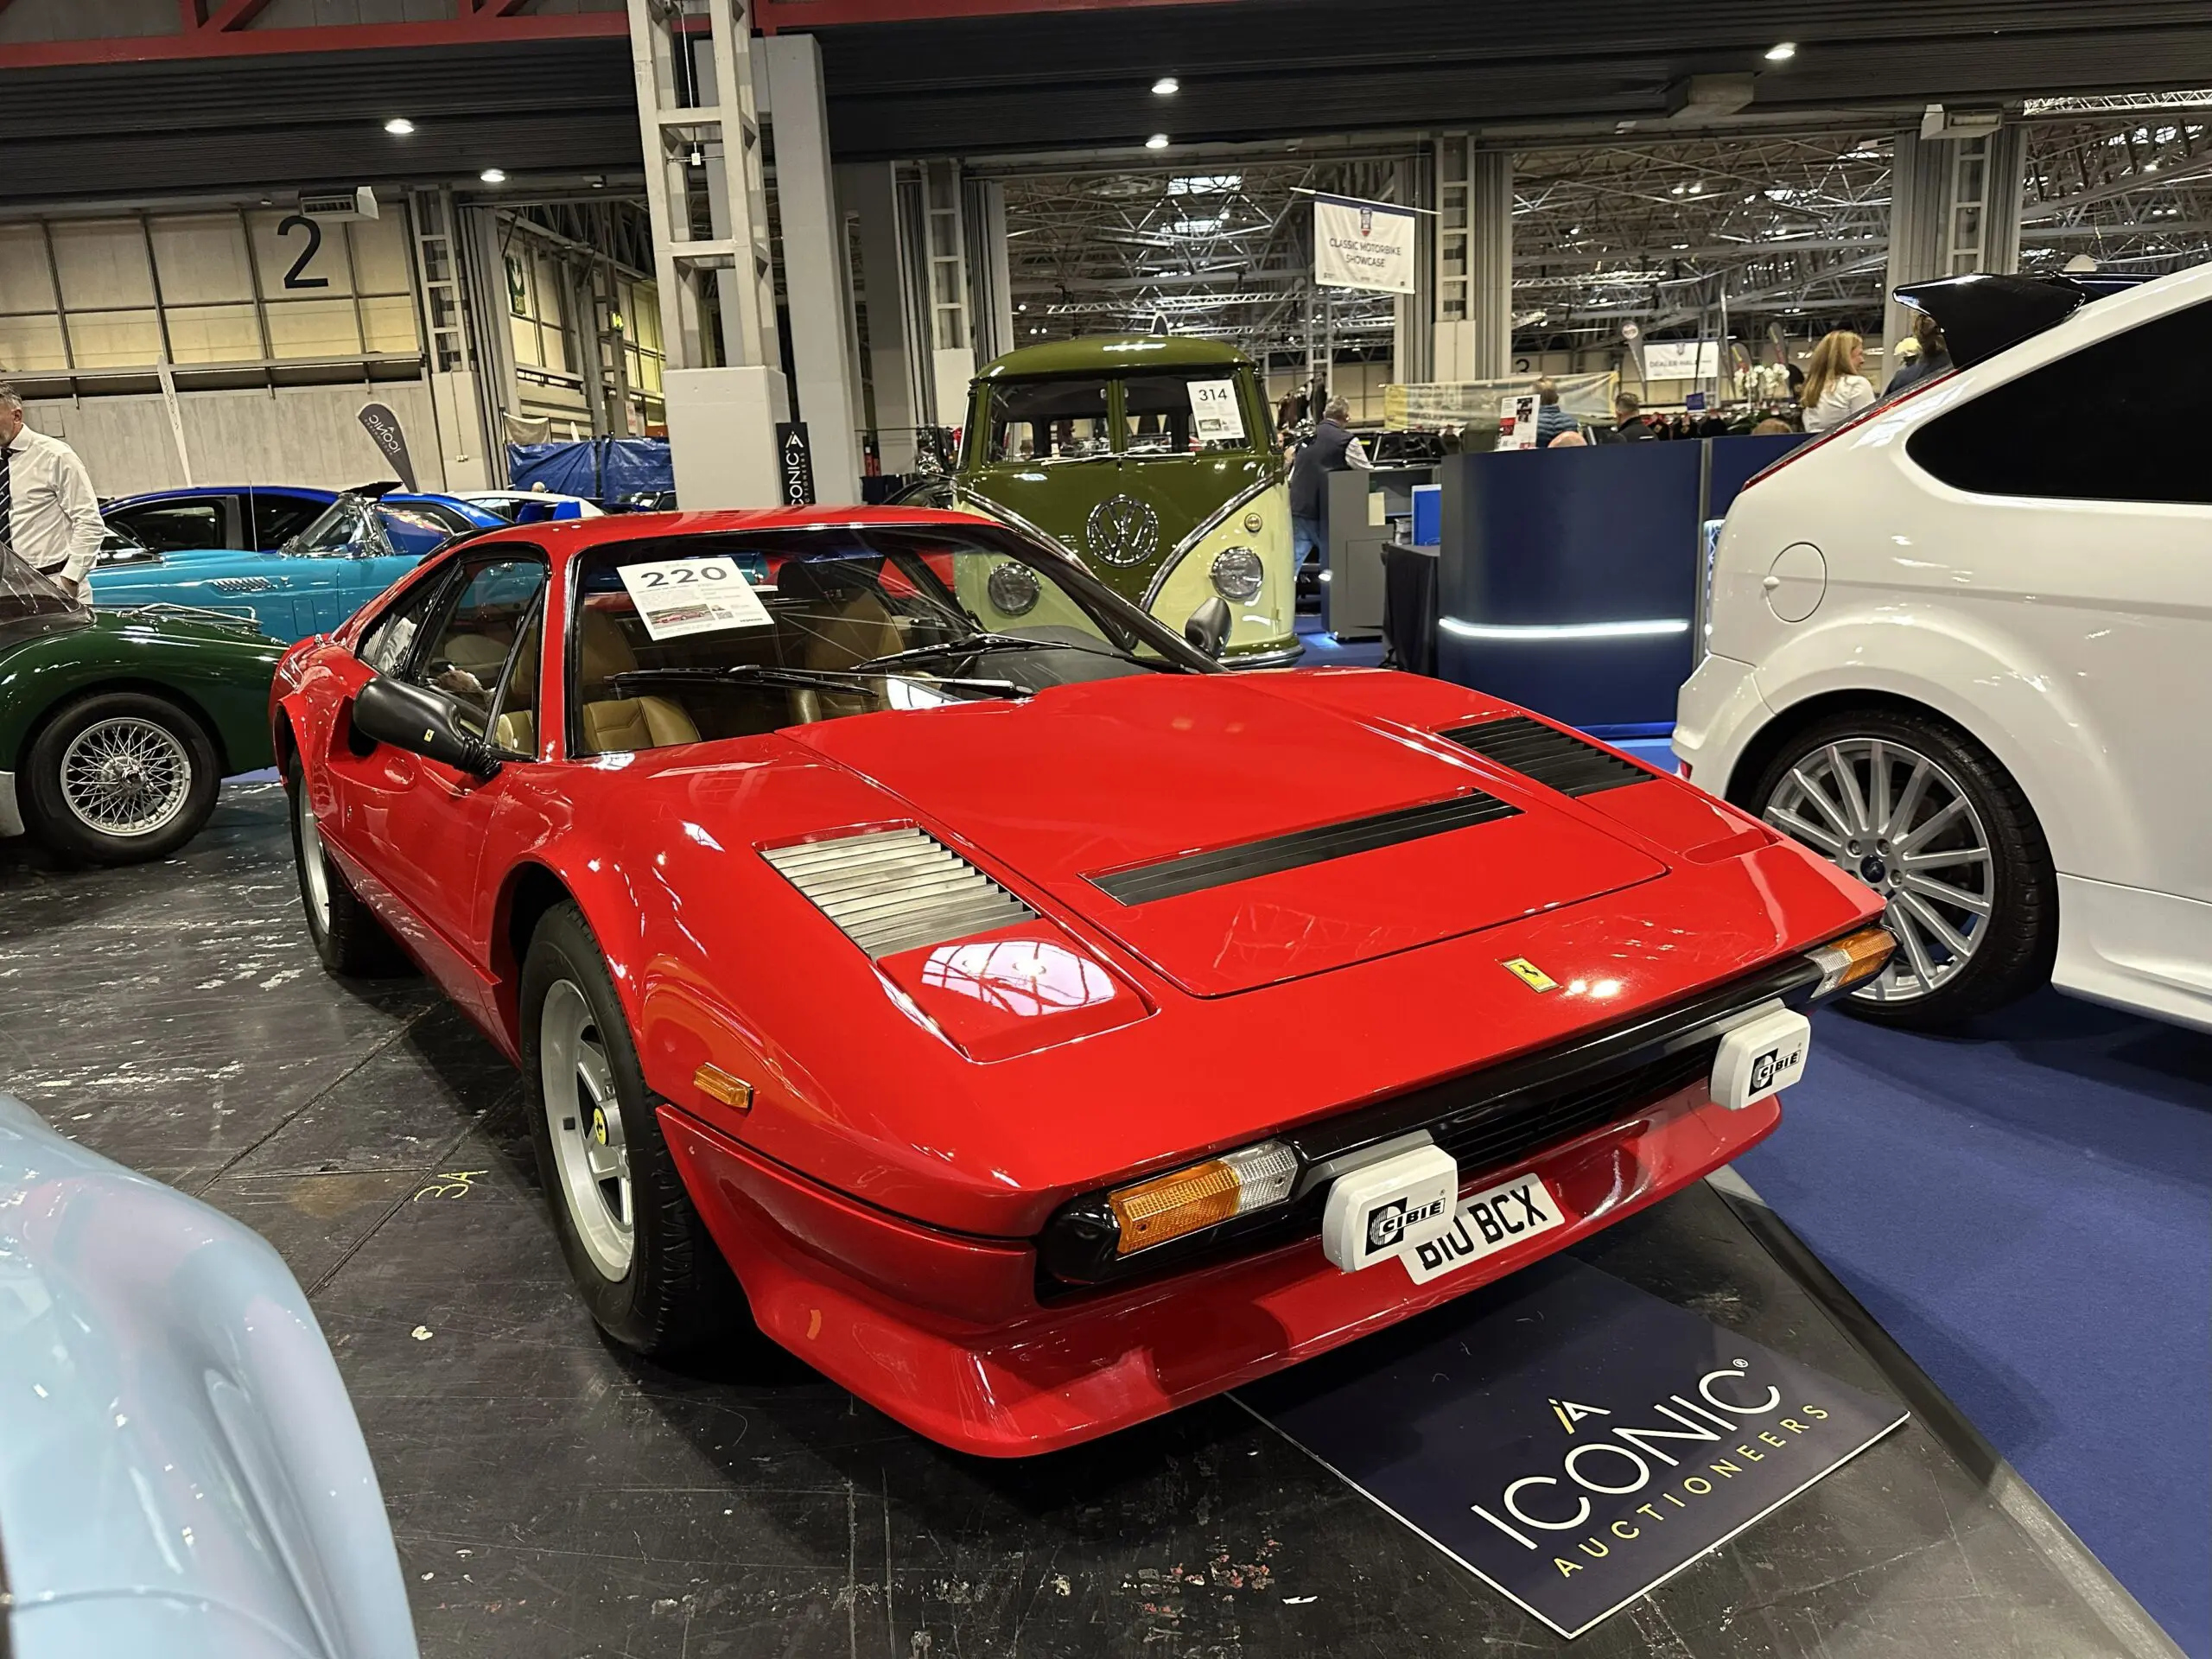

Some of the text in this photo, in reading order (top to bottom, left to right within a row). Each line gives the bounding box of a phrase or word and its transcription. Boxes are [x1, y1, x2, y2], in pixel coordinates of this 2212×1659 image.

[276, 215, 329, 289] 2
[1329, 238, 1402, 256] CLASSIC MOTORBIKE
[1346, 254, 1386, 268] SHOWCASE
[1198, 388, 1228, 401] 314
[640, 566, 728, 588] 220
[1466, 1185, 1548, 1244] BCX
[1471, 1369, 1782, 1550] ICONIC
[1553, 1404, 1829, 1579] AUCTIONEERS
